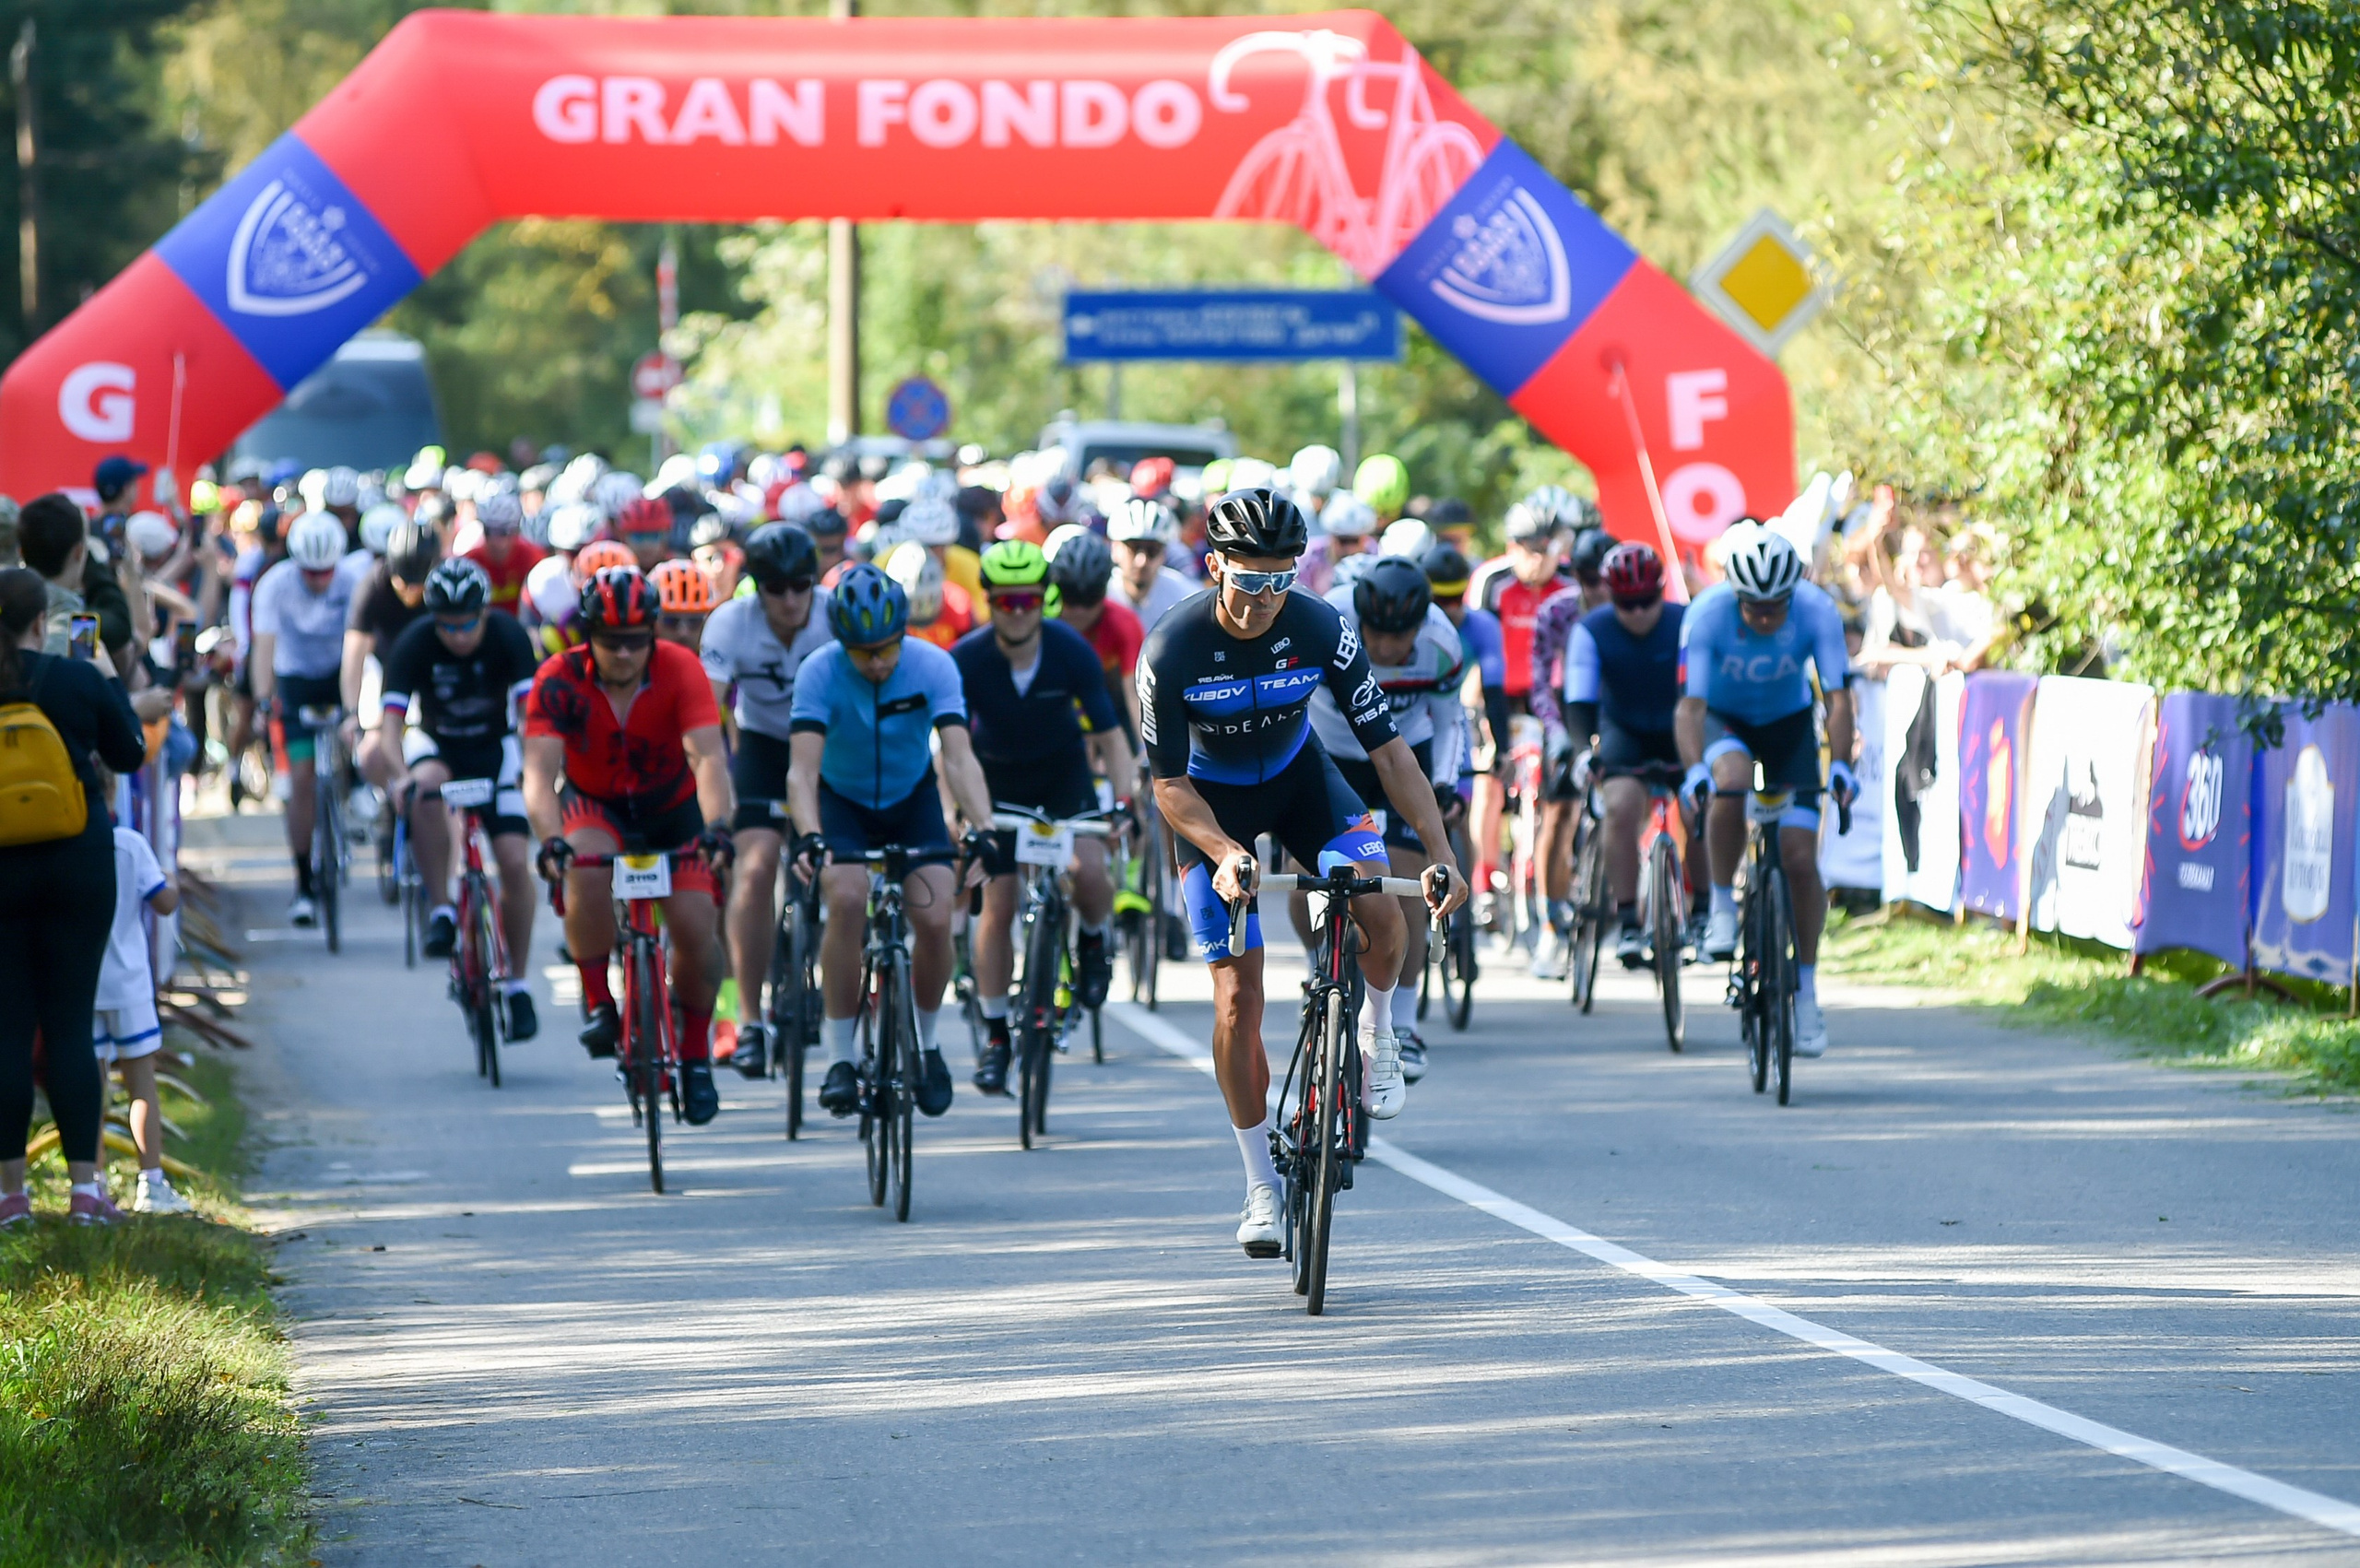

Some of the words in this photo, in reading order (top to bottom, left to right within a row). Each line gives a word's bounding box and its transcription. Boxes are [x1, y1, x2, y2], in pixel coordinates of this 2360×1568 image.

[534, 75, 825, 147] GRAN
[857, 78, 1202, 149] FONDO
[1270, 637, 1292, 654] LEBO
[1276, 656, 1299, 669] GF
[1721, 654, 1799, 683] RCA
[1260, 673, 1320, 690] TEAM
[2183, 750, 2224, 843] 360
